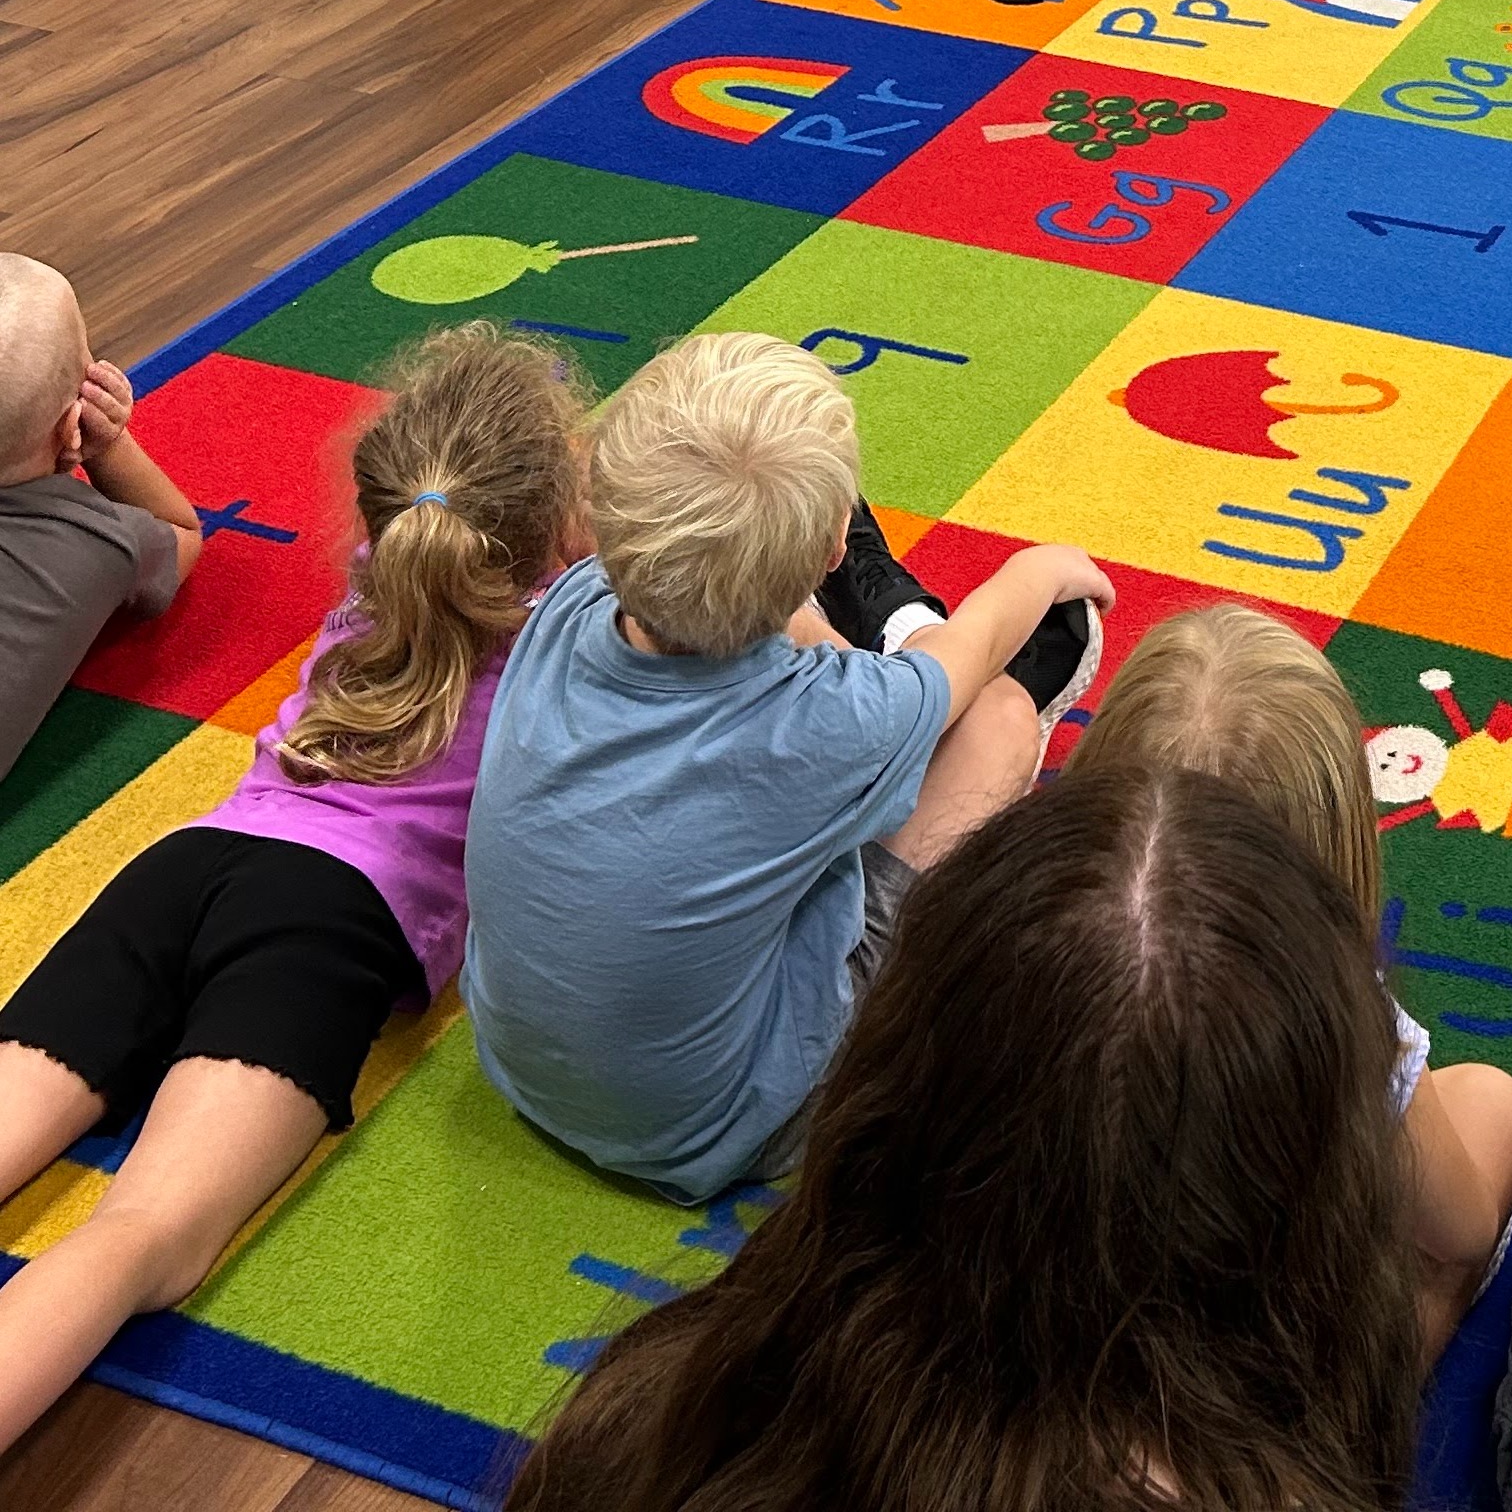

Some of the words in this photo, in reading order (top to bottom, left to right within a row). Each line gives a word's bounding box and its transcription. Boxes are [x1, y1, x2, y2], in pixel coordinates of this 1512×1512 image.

[780, 77, 947, 157] Rr
[1035, 168, 1234, 246] Gg
[1345, 207, 1508, 254] 1
[1204, 466, 1414, 574] Uu
